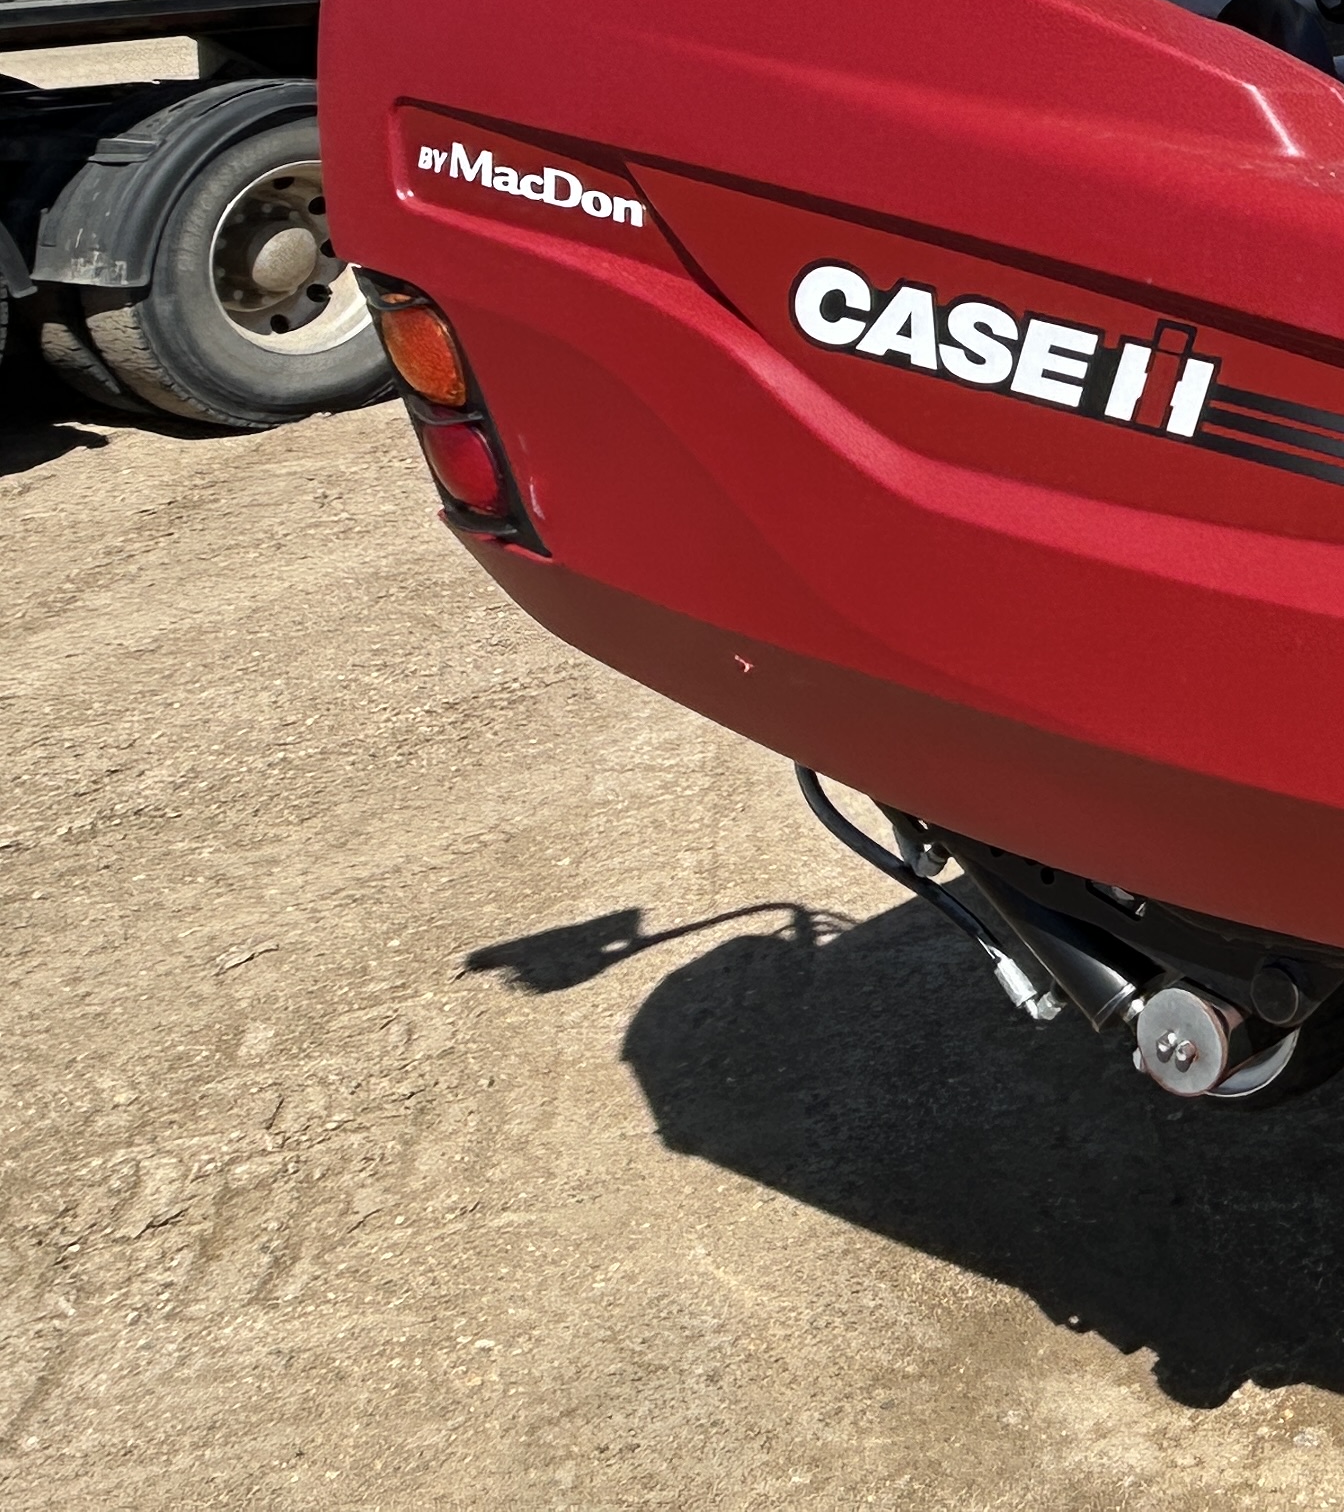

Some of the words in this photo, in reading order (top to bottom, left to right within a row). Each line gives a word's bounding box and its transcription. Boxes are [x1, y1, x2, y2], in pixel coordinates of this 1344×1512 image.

[418, 145, 448, 174] BY
[449, 141, 645, 228] MacDon
[793, 264, 1100, 409] CASE
